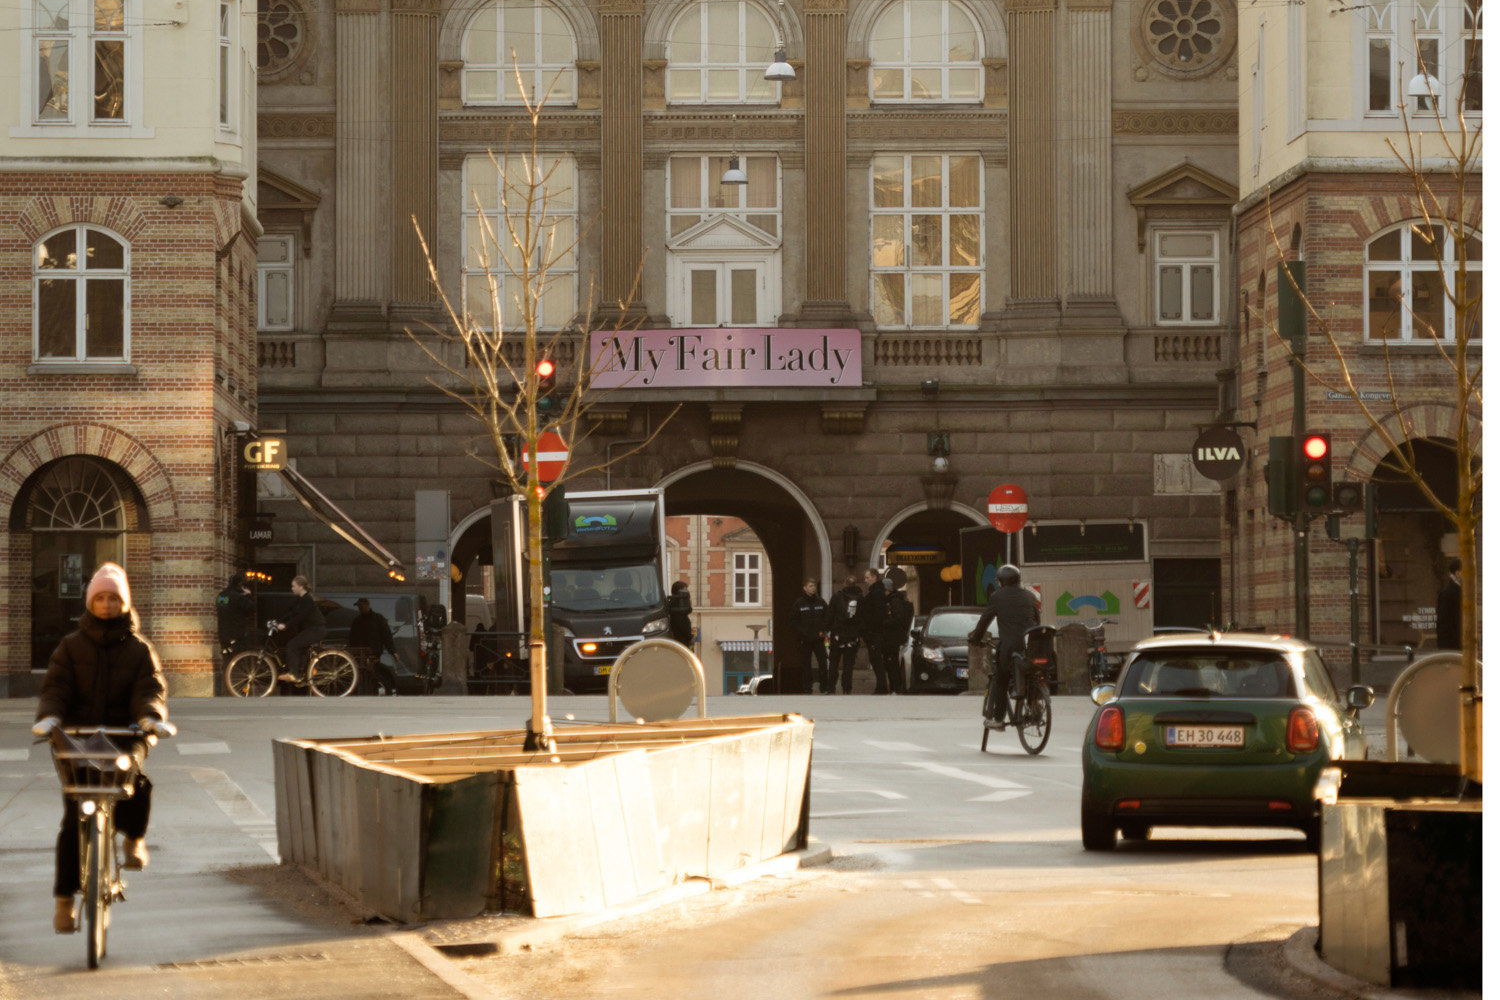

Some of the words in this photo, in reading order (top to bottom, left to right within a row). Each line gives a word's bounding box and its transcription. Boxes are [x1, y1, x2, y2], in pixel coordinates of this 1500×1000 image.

[601, 336, 668, 385] My
[668, 334, 757, 371] Fair
[760, 334, 854, 384] Lady
[243, 440, 281, 463] GF
[1197, 447, 1241, 461] ILVA
[249, 530, 272, 540] LAMAR
[1177, 729, 1195, 742] EH
[1198, 729, 1214, 742] 30
[1216, 730, 1242, 743] 448
